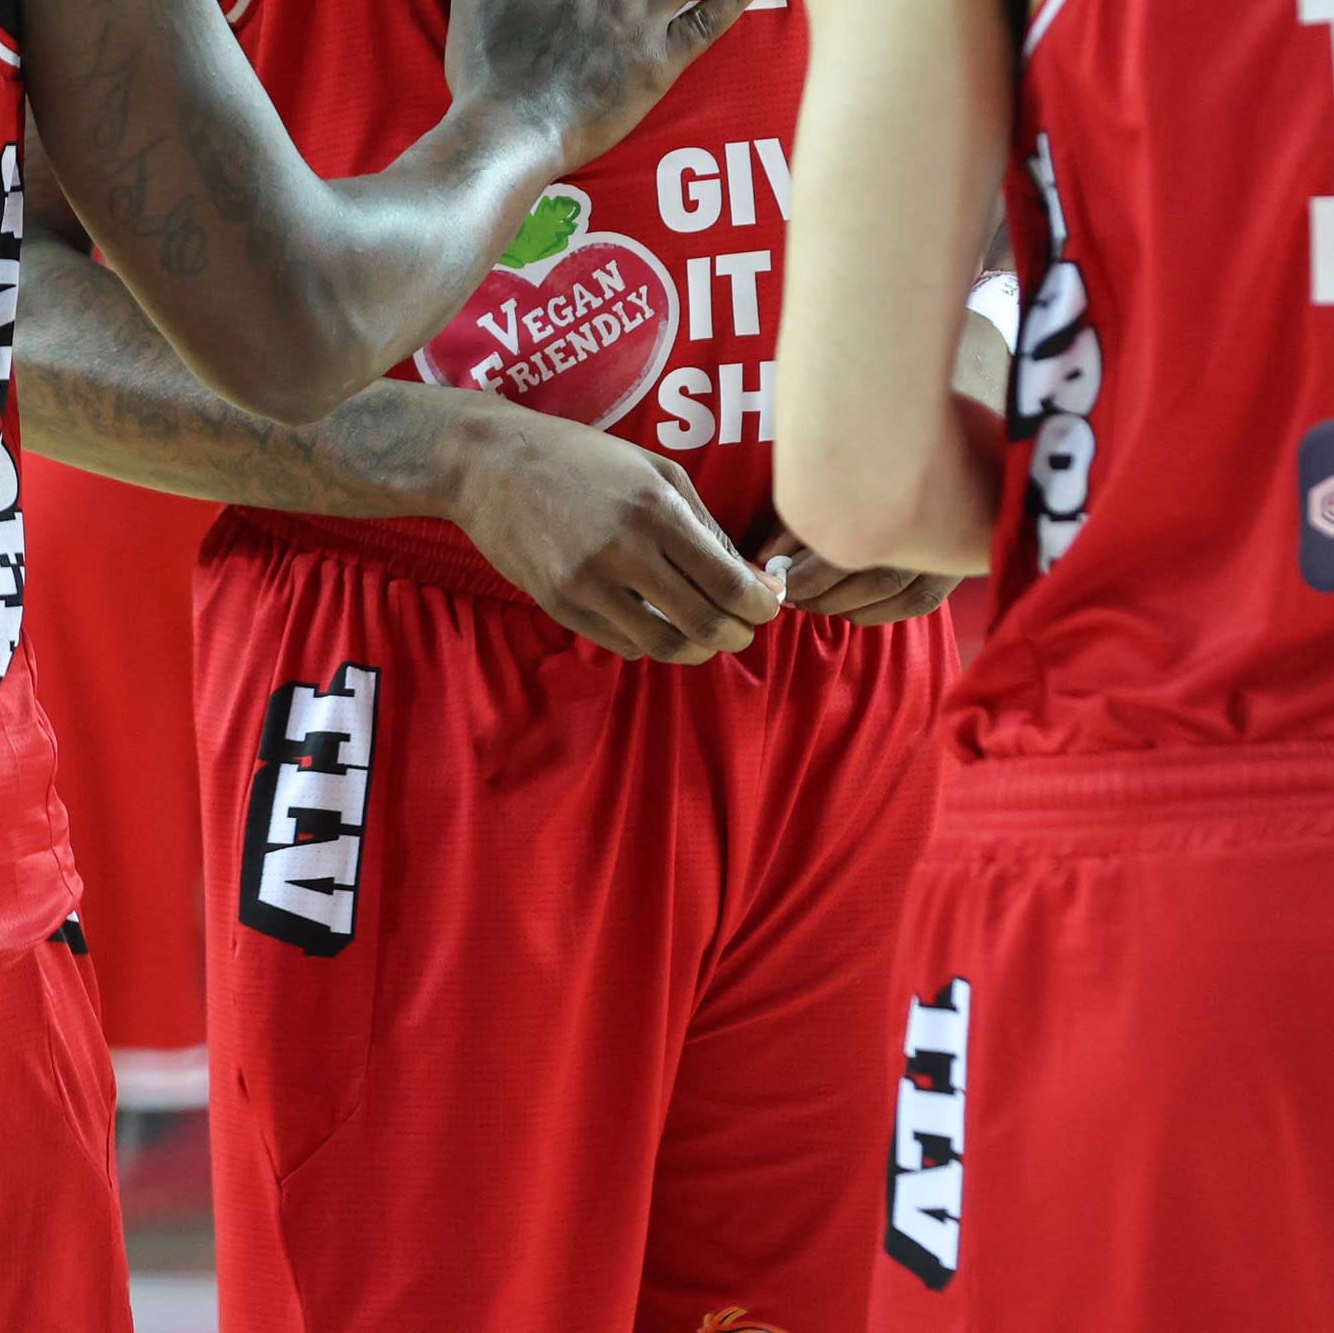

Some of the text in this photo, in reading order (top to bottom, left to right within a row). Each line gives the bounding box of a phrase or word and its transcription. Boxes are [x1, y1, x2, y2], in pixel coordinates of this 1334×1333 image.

[656, 138, 793, 233] GIV
[470, 285, 655, 396] FRIENDLY
[476, 259, 626, 356] VEGAN
[686, 250, 772, 341] IT
[656, 360, 779, 451] SH
[258, 665, 376, 934] TLV
